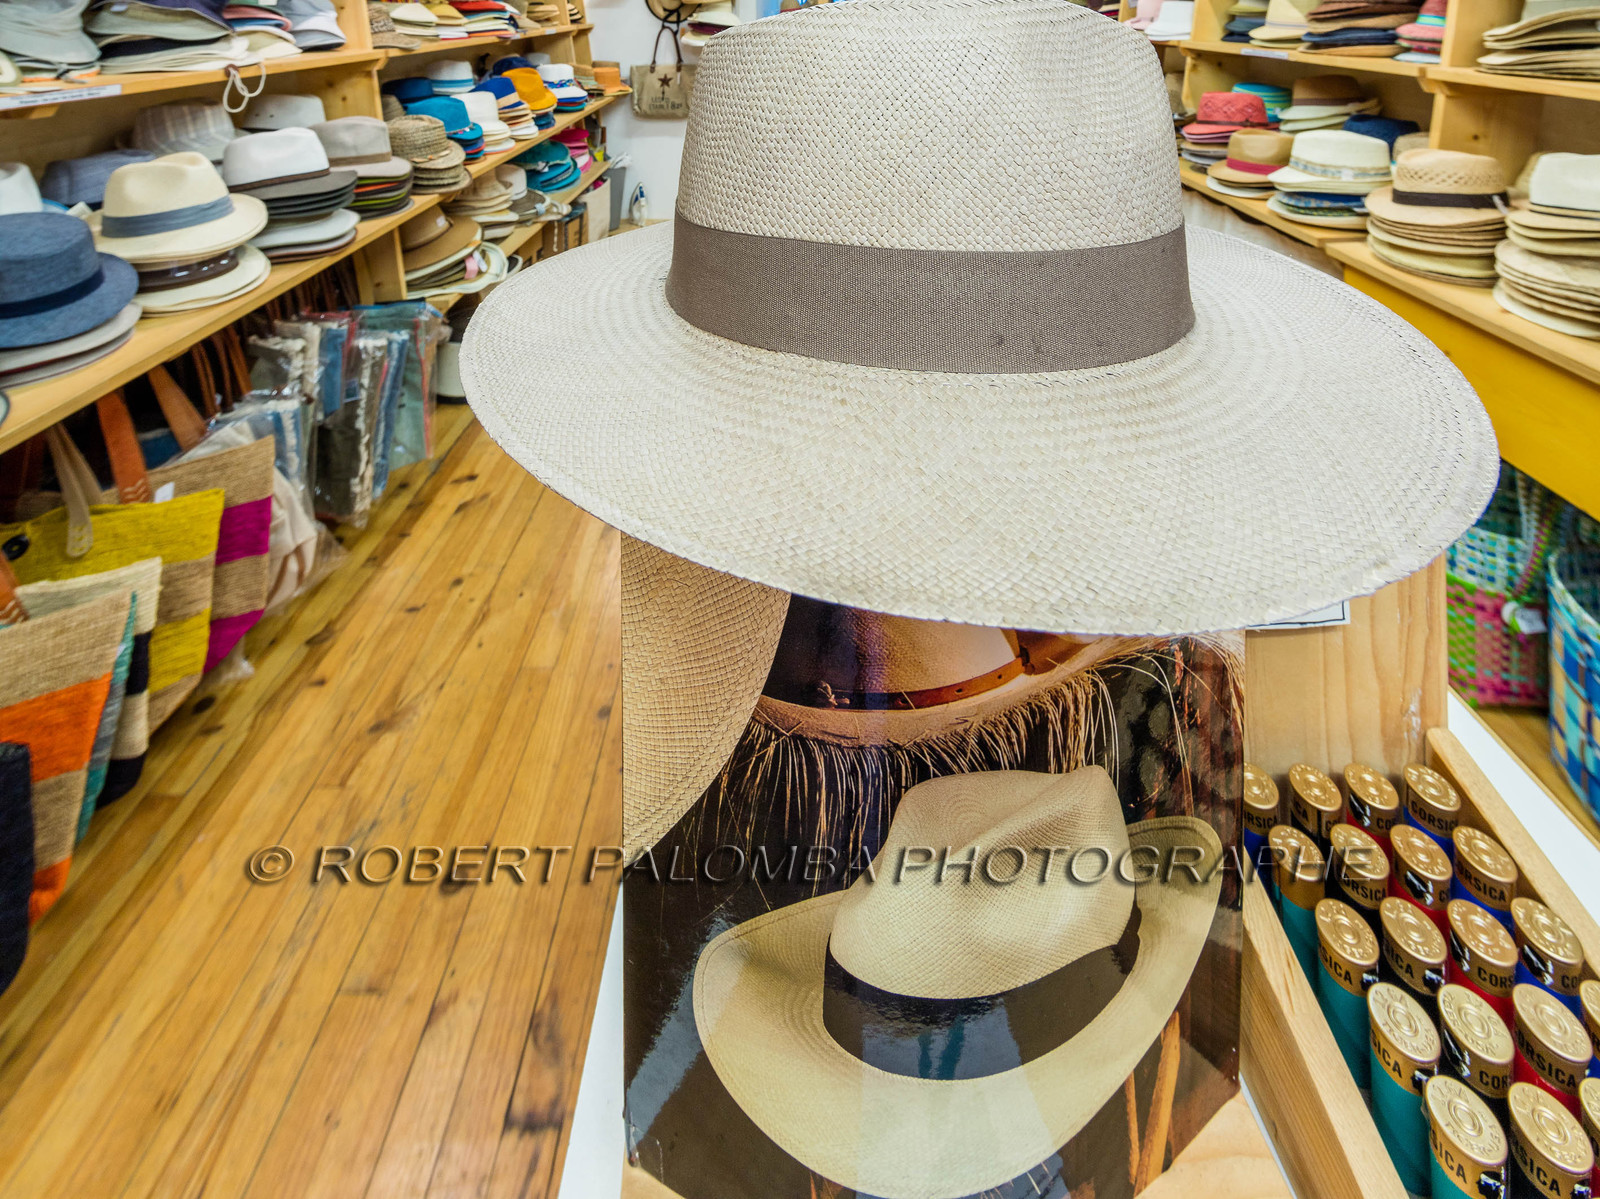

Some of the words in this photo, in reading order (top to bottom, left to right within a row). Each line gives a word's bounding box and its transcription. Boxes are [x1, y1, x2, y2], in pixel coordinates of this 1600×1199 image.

[1411, 800, 1459, 832] CORSIC
[1320, 945, 1354, 986] SICA
[1371, 1028, 1403, 1079] SICA
[1431, 1128, 1468, 1185] SICA
